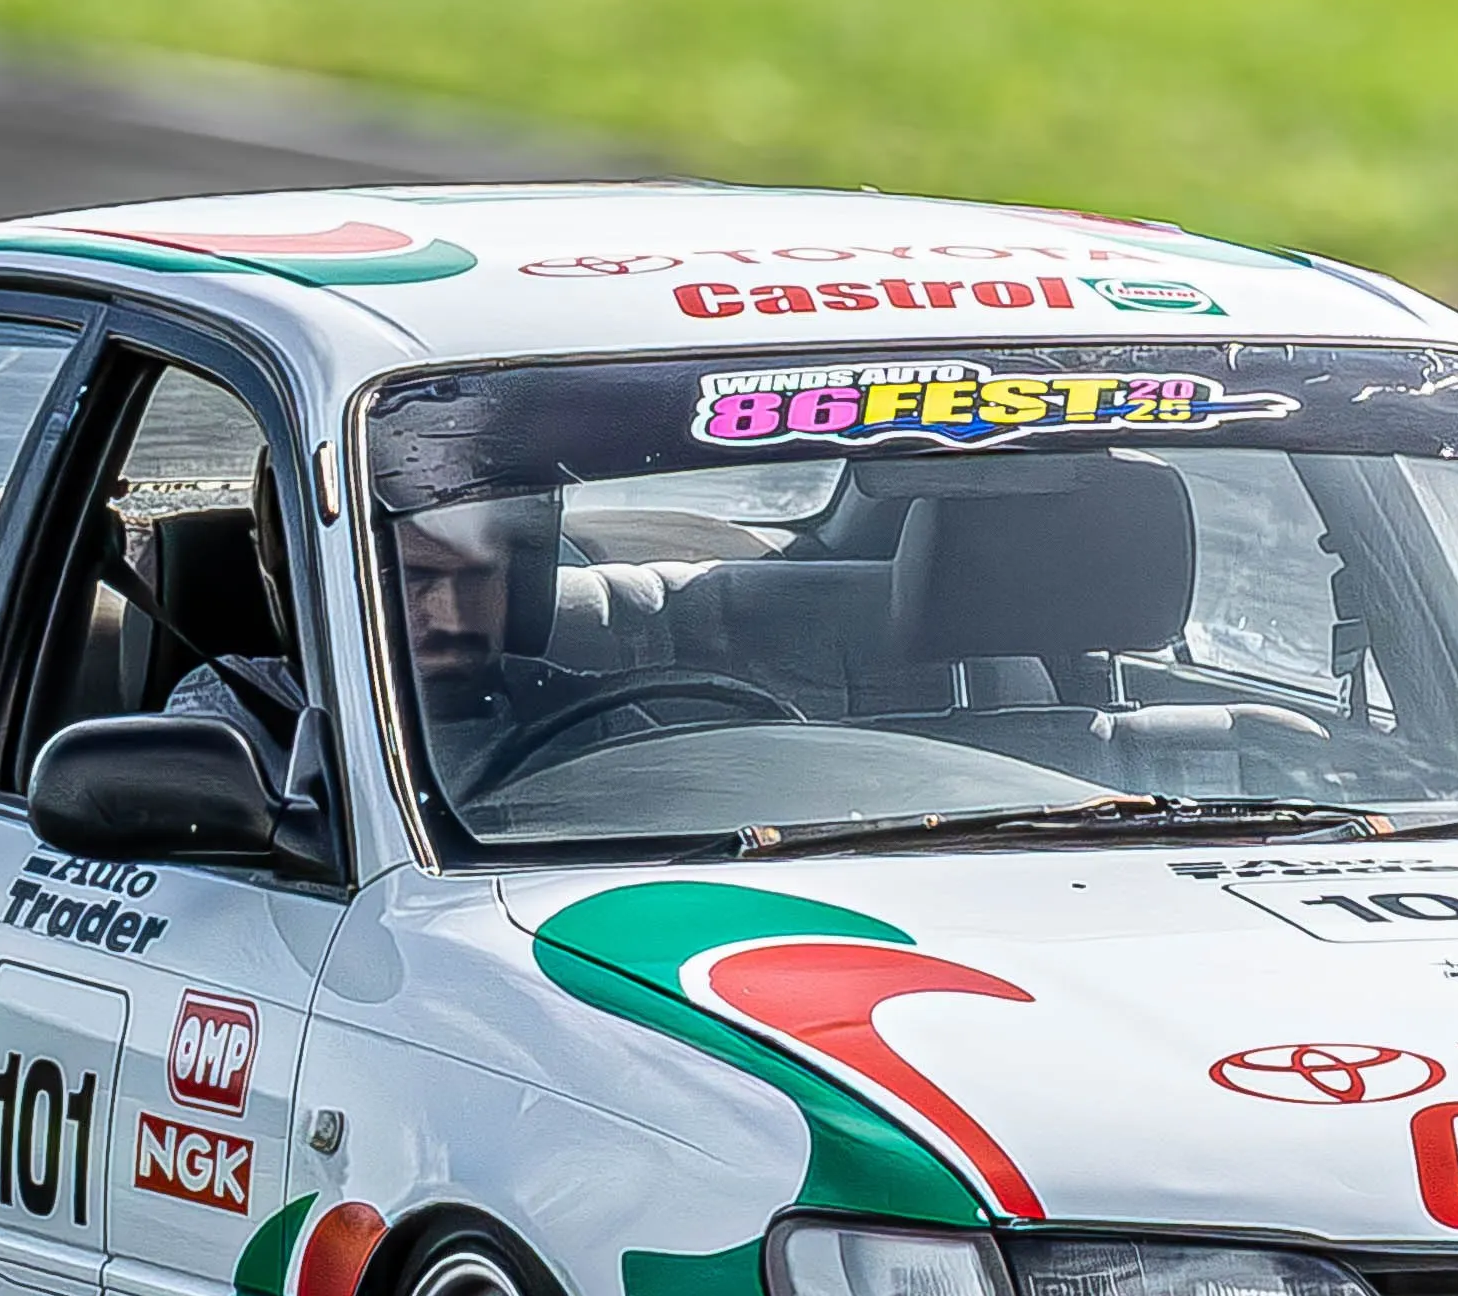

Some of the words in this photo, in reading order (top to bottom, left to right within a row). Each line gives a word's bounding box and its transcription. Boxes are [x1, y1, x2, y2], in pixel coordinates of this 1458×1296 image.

[692, 246, 1163, 265] TOYOTA
[672, 276, 1075, 319] Castrol
[715, 369, 854, 395] WINDS
[858, 365, 965, 385] AUTO
[3, 878, 169, 954] Trader
[177, 1016, 248, 1089] OMP
[139, 1127, 249, 1205] NGK
